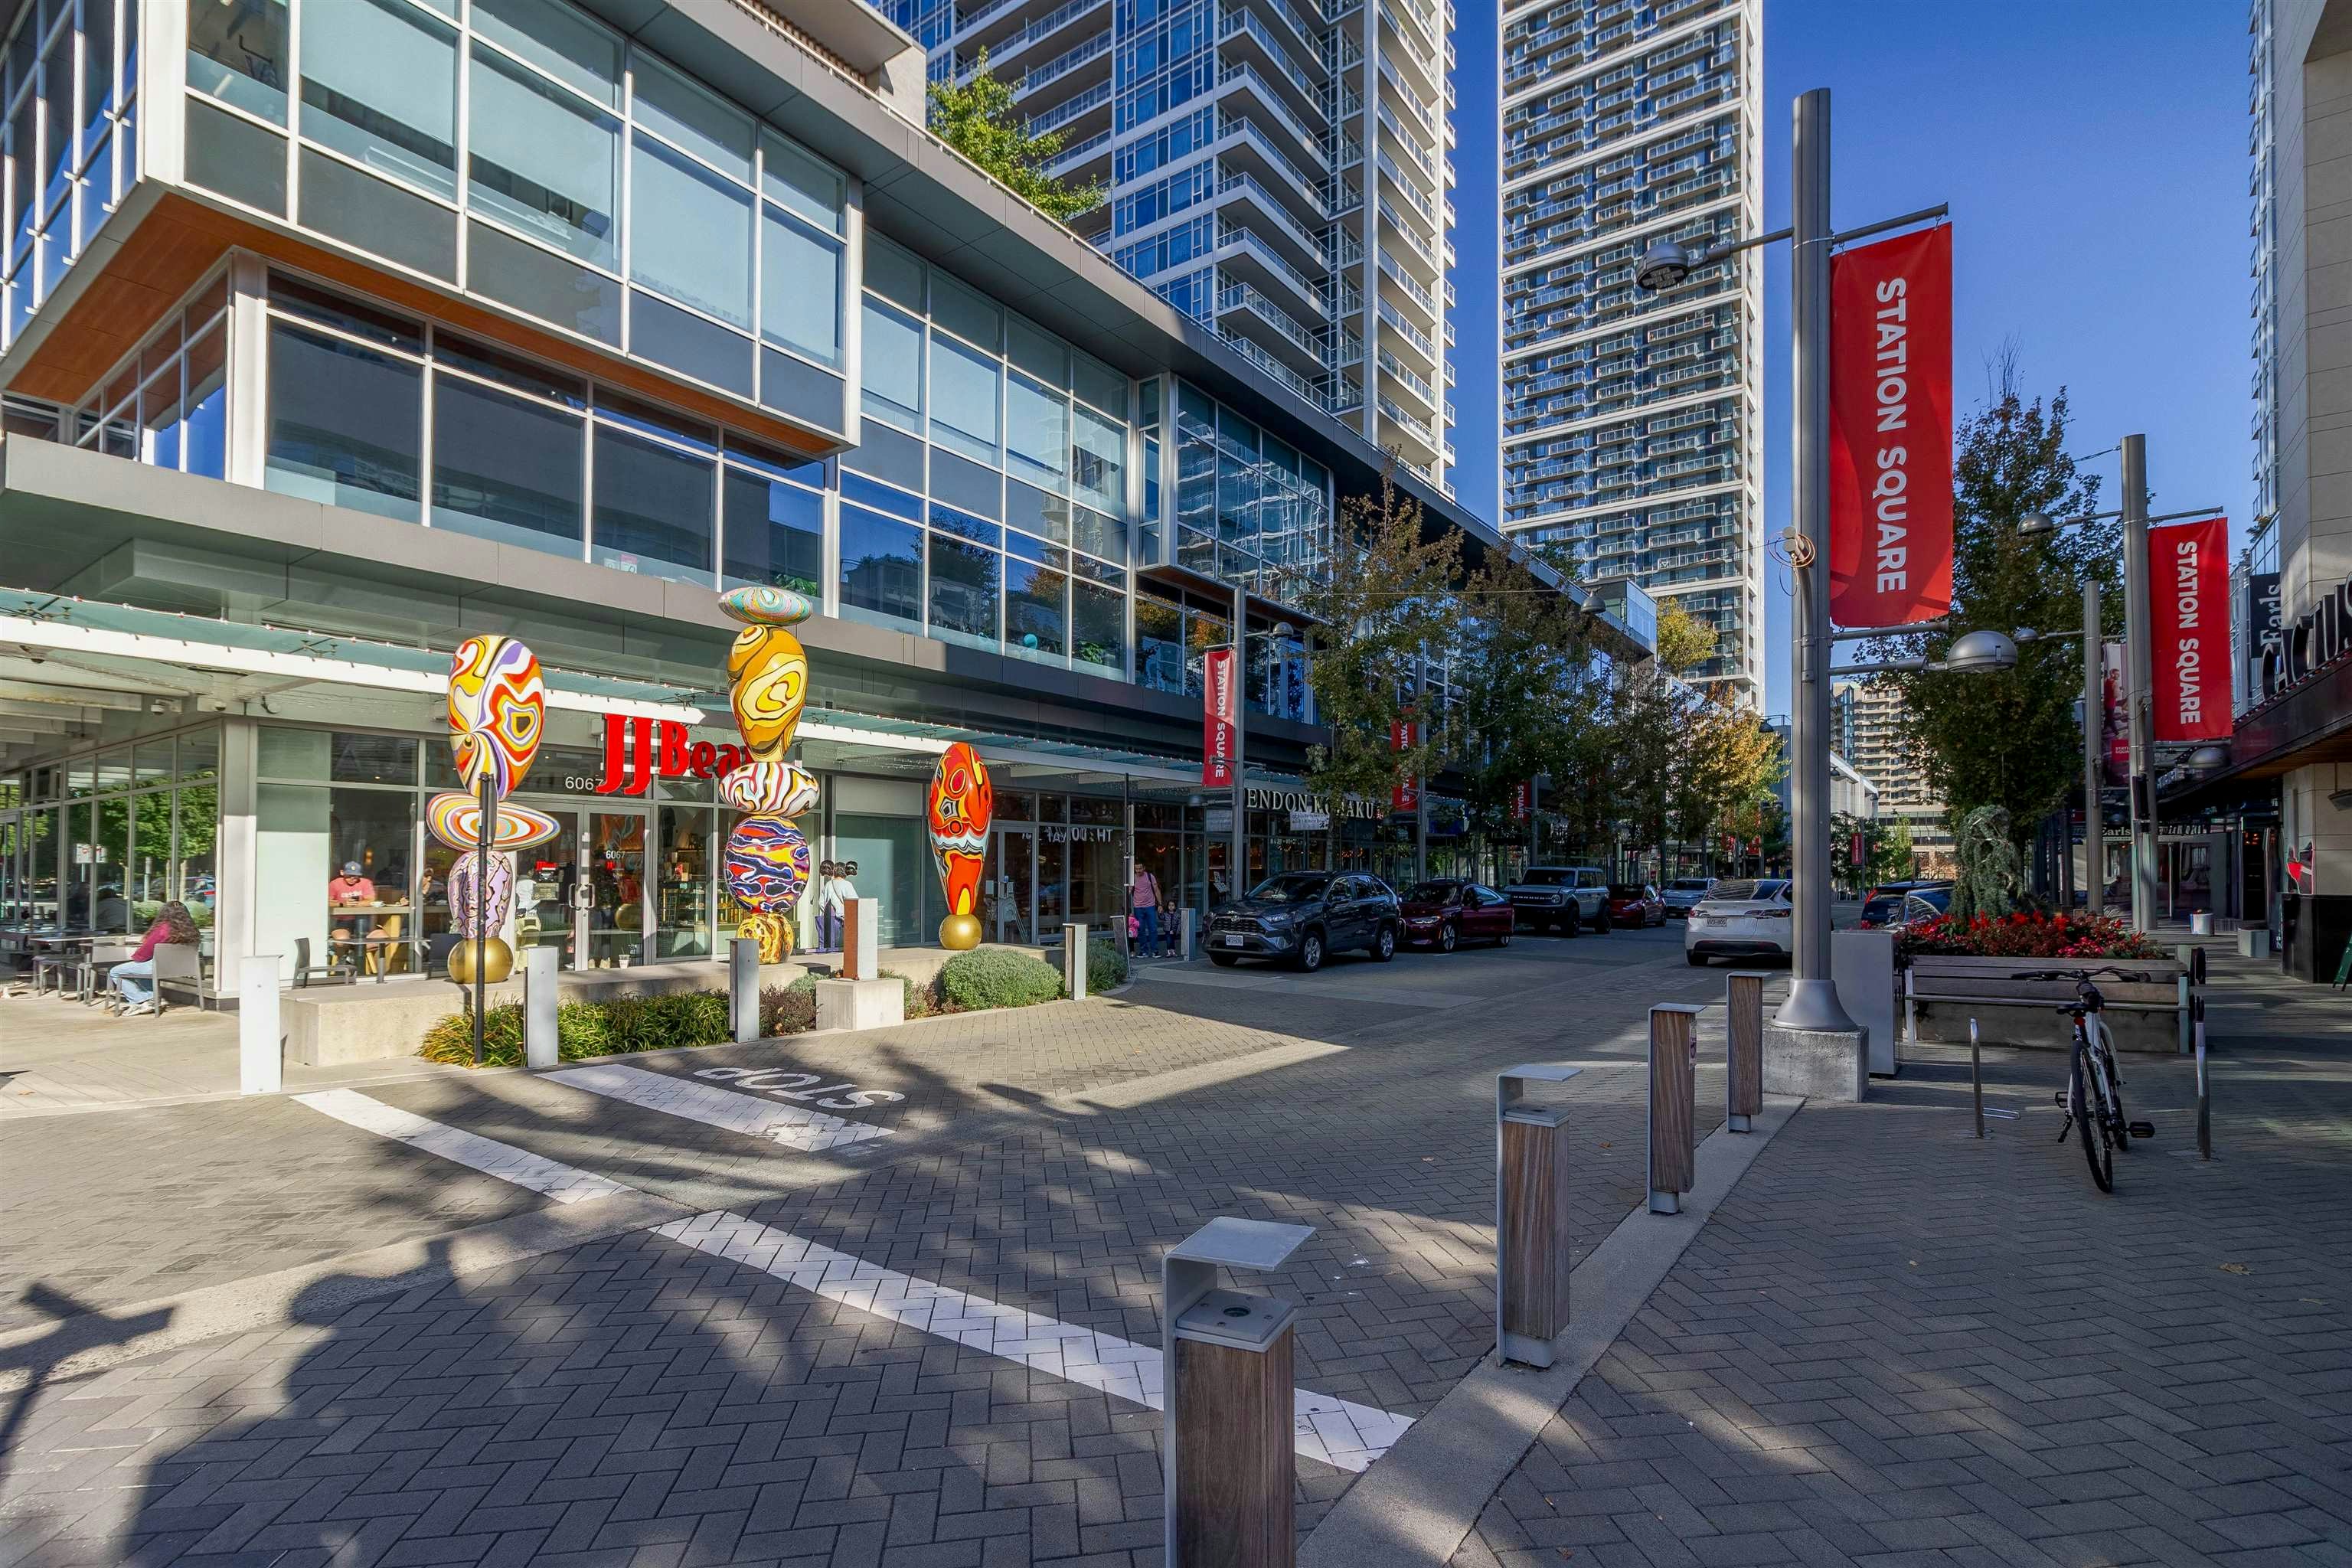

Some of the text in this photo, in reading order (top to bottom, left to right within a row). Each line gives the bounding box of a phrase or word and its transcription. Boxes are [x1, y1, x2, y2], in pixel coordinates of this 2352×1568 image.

[1872, 276, 1907, 593] STATION SQUARE
[2176, 540, 2201, 725] STATION SQUARE
[1217, 661, 1226, 717] STATION
[565, 776, 605, 791] 6067
[1246, 788, 1308, 812] ENDON
[606, 850, 626, 859] 6067
[694, 1067, 906, 1109] STOP
